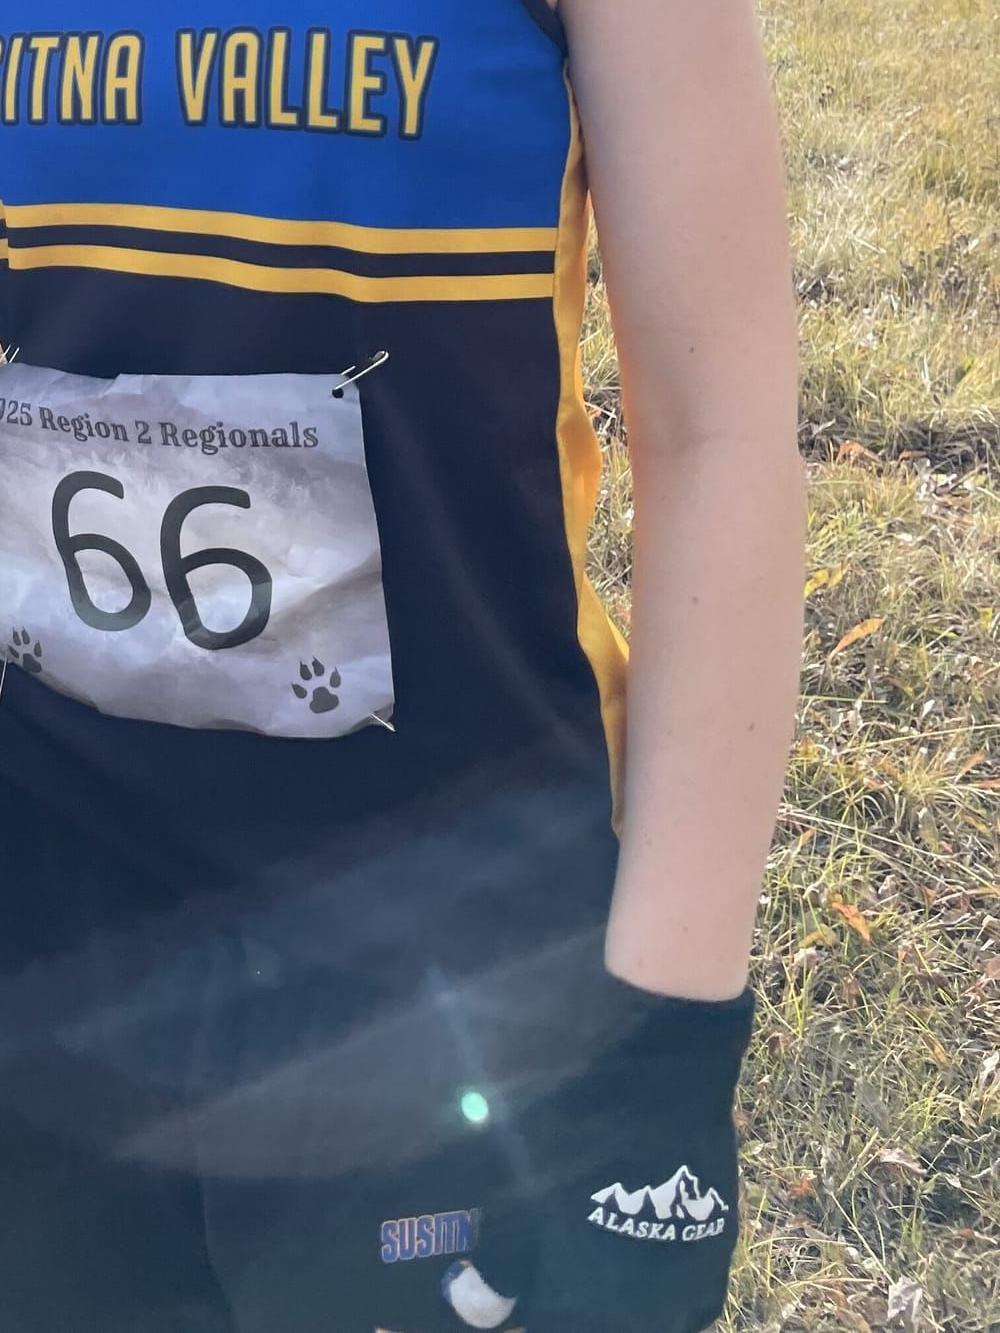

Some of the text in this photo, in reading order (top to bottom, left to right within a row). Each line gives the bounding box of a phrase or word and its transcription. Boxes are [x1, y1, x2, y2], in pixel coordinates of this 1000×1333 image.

[175, 26, 438, 140] VALLEY
[40, 406, 129, 442] Region
[135, 420, 152, 445] 2
[160, 421, 319, 455] Regionals
[51, 470, 273, 650] 66
[381, 1208, 481, 1263] SUSITN
[587, 1206, 725, 1242] ALASKA GEAR
